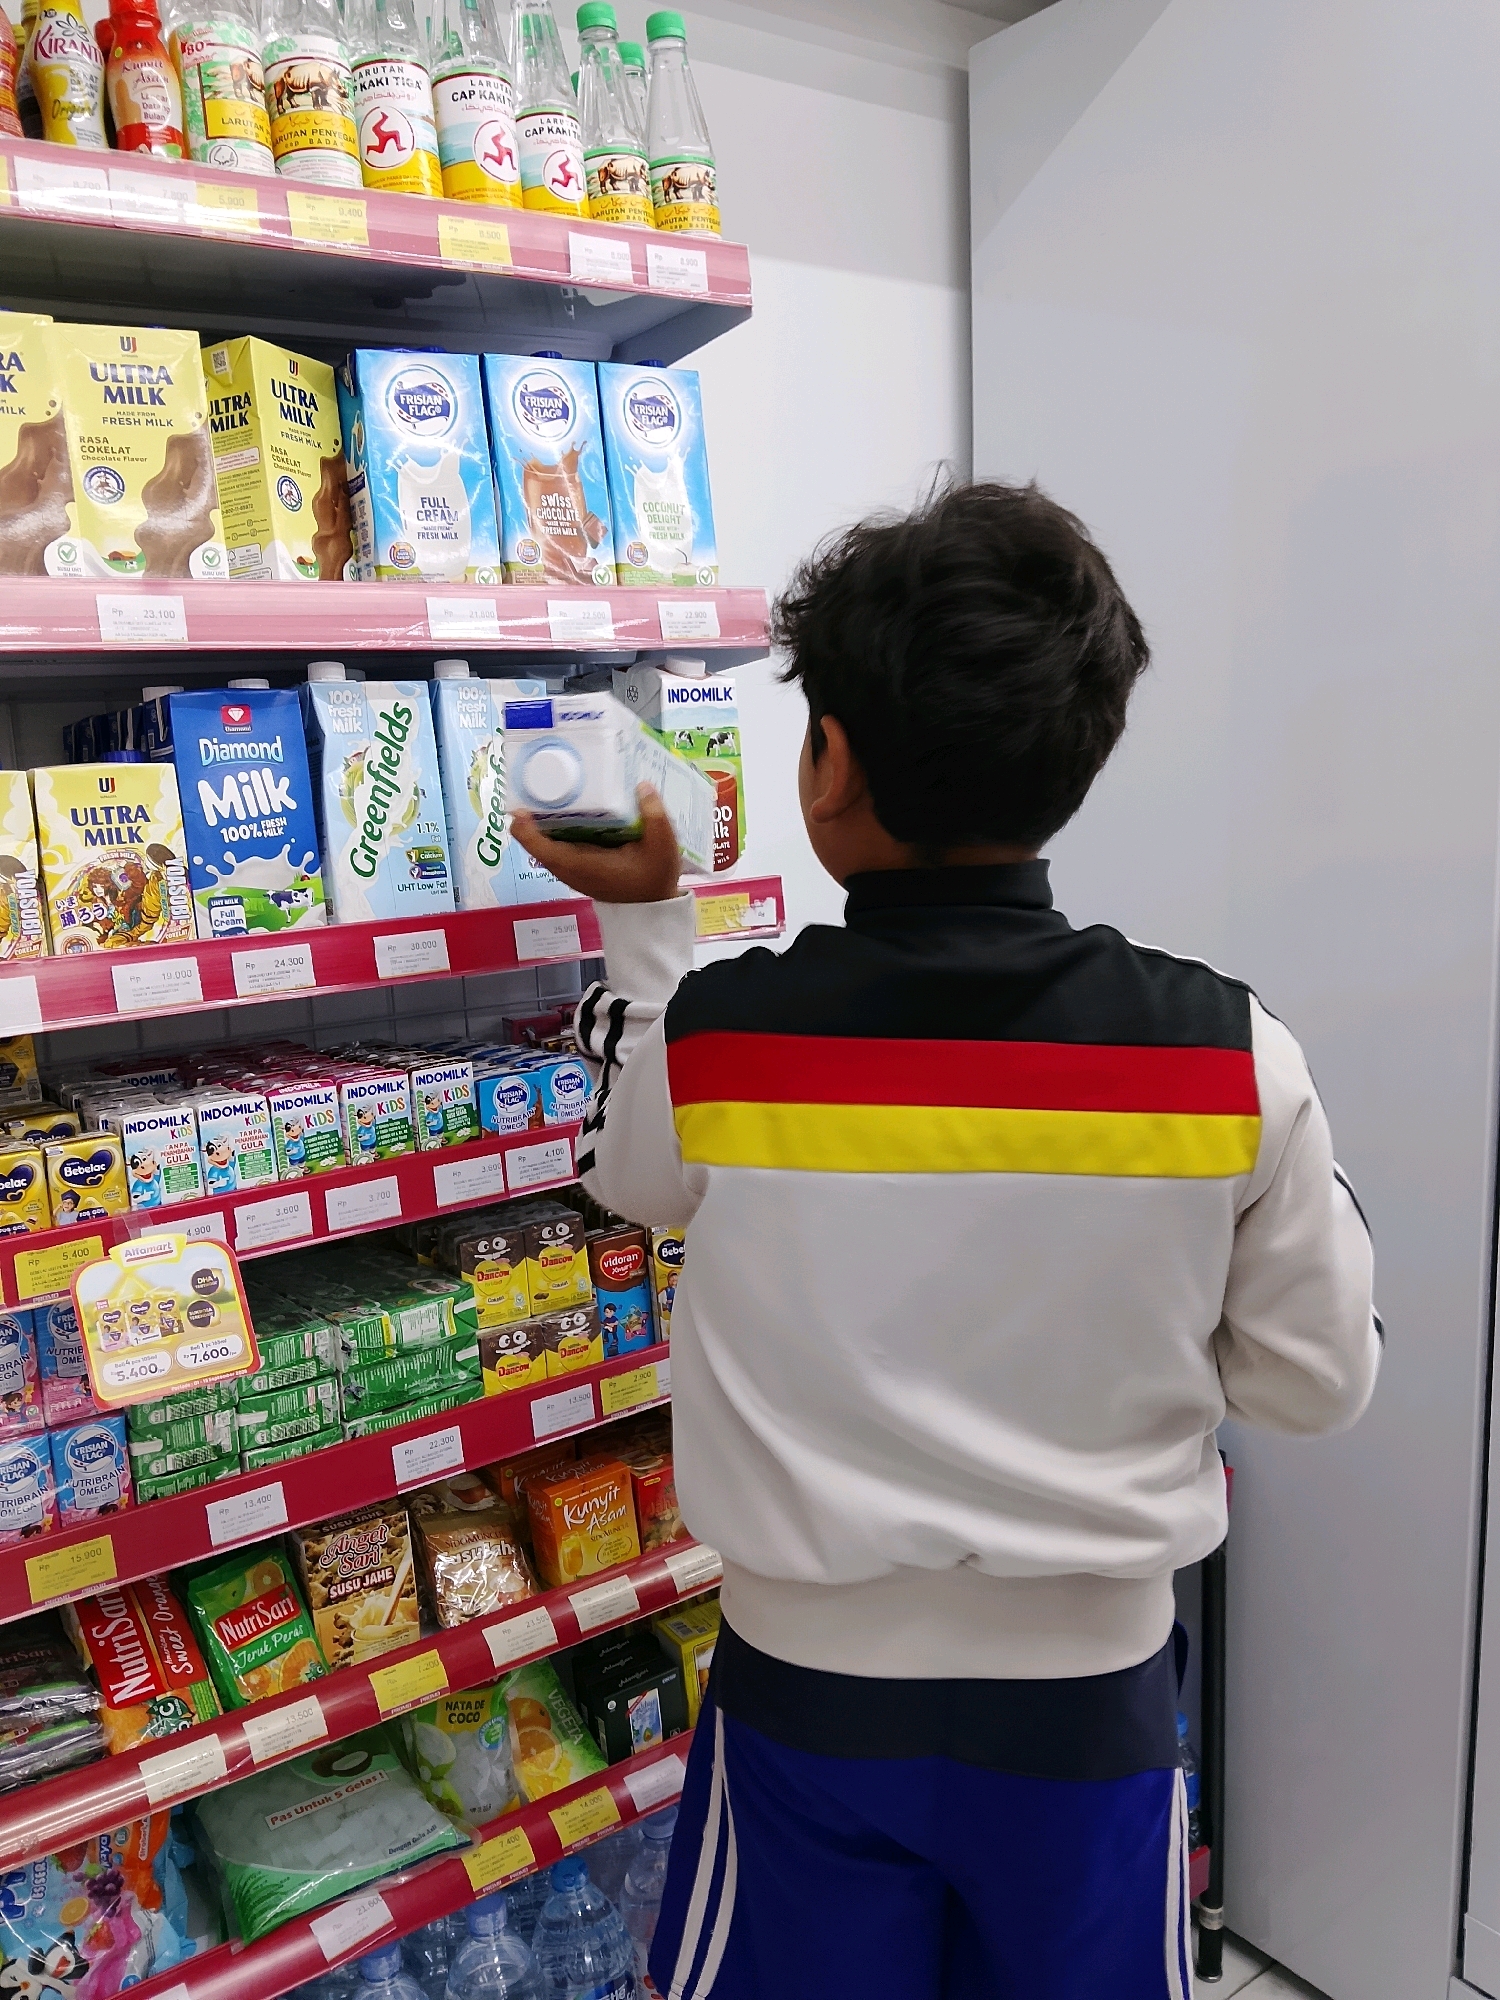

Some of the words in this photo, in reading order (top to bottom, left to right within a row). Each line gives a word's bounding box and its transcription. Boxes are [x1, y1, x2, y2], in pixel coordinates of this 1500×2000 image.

[353, 65, 405, 83] LARUTAN
[359, 76, 389, 93] KAKI
[392, 76, 422, 91] TIGA
[451, 90, 476, 102] CAP
[479, 90, 507, 104] KAKI
[221, 117, 265, 134] LARUTAN
[524, 127, 544, 138] CAP
[547, 127, 571, 138] KAKI
[592, 207, 626, 219] LARUTAN
[657, 216, 689, 228] LARUTAN
[89, 361, 174, 386] ULTRA
[103, 385, 167, 407] MILK
[269, 378, 319, 413] ULTRA
[400, 394, 443, 407] FRISIAN
[524, 395, 563, 410] FRISIAN
[279, 401, 316, 430] MILK
[408, 404, 436, 417] FLAG
[532, 406, 556, 419] FLAG
[634, 404, 669, 418] FRISIAN
[101, 416, 142, 427] FRESH
[145, 418, 174, 428] MILK
[210, 410, 249, 434] MILK
[641, 415, 663, 426] FLAG
[79, 435, 110, 445] RASA
[280, 430, 303, 445] FRESH
[305, 438, 323, 450] MILK
[80, 445, 132, 455] COKELAT
[81, 454, 121, 462] Chocolate
[122, 455, 148, 463] Flavor
[271, 453, 302, 469] COKELAT
[420, 496, 450, 510] FULL
[540, 493, 572, 508] SWISS
[536, 507, 580, 522] CHOCOLATE
[642, 502, 686, 516] COCONUT
[416, 509, 459, 526] CREAM
[647, 513, 682, 525] DELIGHT
[417, 532, 440, 540] FRESH
[441, 532, 459, 540] MILK
[542, 526, 561, 536] FRESH
[562, 527, 578, 537] MILK
[111, 607, 124, 617] Rp
[143, 609, 176, 620] 23.100
[327, 690, 362, 705] 100%
[456, 686, 488, 701] 100%
[667, 686, 734, 704] INDOMILK
[327, 704, 363, 719] Fresh
[456, 700, 488, 714] Fresh
[332, 717, 364, 734] Milk
[458, 713, 488, 730] Milk
[198, 735, 284, 767] Diamond
[197, 767, 298, 828] Milk
[349, 701, 414, 879] Greenfields
[70, 804, 152, 827] ULTRA
[220, 822, 263, 844] 100%
[260, 816, 288, 830] FRESH
[262, 827, 285, 840] MILK
[416, 821, 440, 835] 1.1%
[84, 825, 144, 847] MILK
[99, 852, 119, 862] FRESH
[119, 851, 136, 861] MILK
[165, 857, 192, 921] YOASOBI
[397, 883, 416, 892] UHT
[416, 882, 434, 891] Low
[435, 880, 448, 890] Fat
[14, 869, 42, 936] YOASOBI
[220, 910, 236, 918] Full
[213, 918, 245, 928] Cream
[531, 927, 540, 936] Rp
[387, 944, 397, 953] Rp
[410, 939, 437, 951] 30.000
[245, 961, 256, 970] Rp
[274, 956, 305, 968] 24.300
[129, 974, 142, 983] Rp
[161, 968, 193, 980] 19.000
[415, 1066, 469, 1086] INDOMILK
[347, 1080, 405, 1100] INDOMILK
[272, 1092, 334, 1113] INDOMILK
[550, 1096, 592, 1111] NUTRIBRAIN
[200, 1101, 264, 1122] INDOMILK
[491, 1109, 536, 1124] NUTRIBRAIN
[560, 1108, 584, 1118] OMEGA
[125, 1113, 191, 1134] INDOMILK
[500, 1121, 526, 1131] OMEGA
[239, 1128, 263, 1138] TANPA
[164, 1142, 189, 1151] TANPA
[240, 1140, 264, 1150] GULA
[166, 1153, 190, 1164] GULA
[518, 1155, 527, 1163] Rp
[544, 1147, 565, 1158] 4.100
[64, 1162, 106, 1178] Bebelac
[337, 1200, 347, 1208] Rp
[368, 1190, 391, 1202] 3.700
[246, 1214, 256, 1222] Rp
[275, 1204, 299, 1217] 3.600
[186, 1225, 212, 1237] 4.900
[28, 1258, 40, 1267] Rp
[62, 1247, 90, 1261] 5.400
[124, 1242, 172, 1258] Alfamart
[541, 1254, 573, 1268] Dancow
[603, 1253, 639, 1268] vidoran
[197, 1276, 213, 1285] DHA
[476, 1269, 510, 1282] Dancow
[190, 1346, 230, 1364] 7.600
[560, 1345, 590, 1359] Dancow
[116, 1362, 158, 1382] 5.400
[498, 1364, 530, 1377] Dancow
[74, 1440, 109, 1456] FRISIAN
[404, 1448, 414, 1456] Rp
[428, 1435, 455, 1450] 22.300
[81, 1450, 104, 1462] FLAG
[2, 1471, 25, 1481] FLAG
[65, 1465, 125, 1488] NUTRIBRAIN
[79, 1482, 115, 1497] OMEGA
[0, 1502, 37, 1518] OMEGA
[218, 1507, 230, 1516] Rp
[243, 1493, 272, 1509] 13.400
[563, 1485, 621, 1531] Kunyit
[321, 1519, 352, 1534] SUSU
[354, 1509, 385, 1524] JAHE
[586, 1504, 628, 1535] Asam
[318, 1523, 390, 1569] Anget
[38, 1563, 50, 1572] Rp
[337, 1545, 381, 1579] Sari
[328, 1580, 362, 1600] SUSU
[362, 1566, 395, 1588] JAHE
[218, 1596, 296, 1646] NutriSari
[271, 1623, 304, 1647] Peras
[91, 1587, 156, 1705] NutriSari
[166, 1625, 194, 1675] Sweet
[445, 1701, 473, 1712] NATA
[474, 1699, 486, 1709] DE
[448, 1711, 481, 1725] COCO
[547, 1688, 584, 1746] VEGETA
[269, 1811, 294, 1827] Pas
[295, 1791, 334, 1816] Untuk
[335, 1789, 344, 1799] 5
[344, 1774, 379, 1795] Gelas
[579, 1794, 603, 1810] 14.000
[498, 1832, 521, 1849] 7.400
